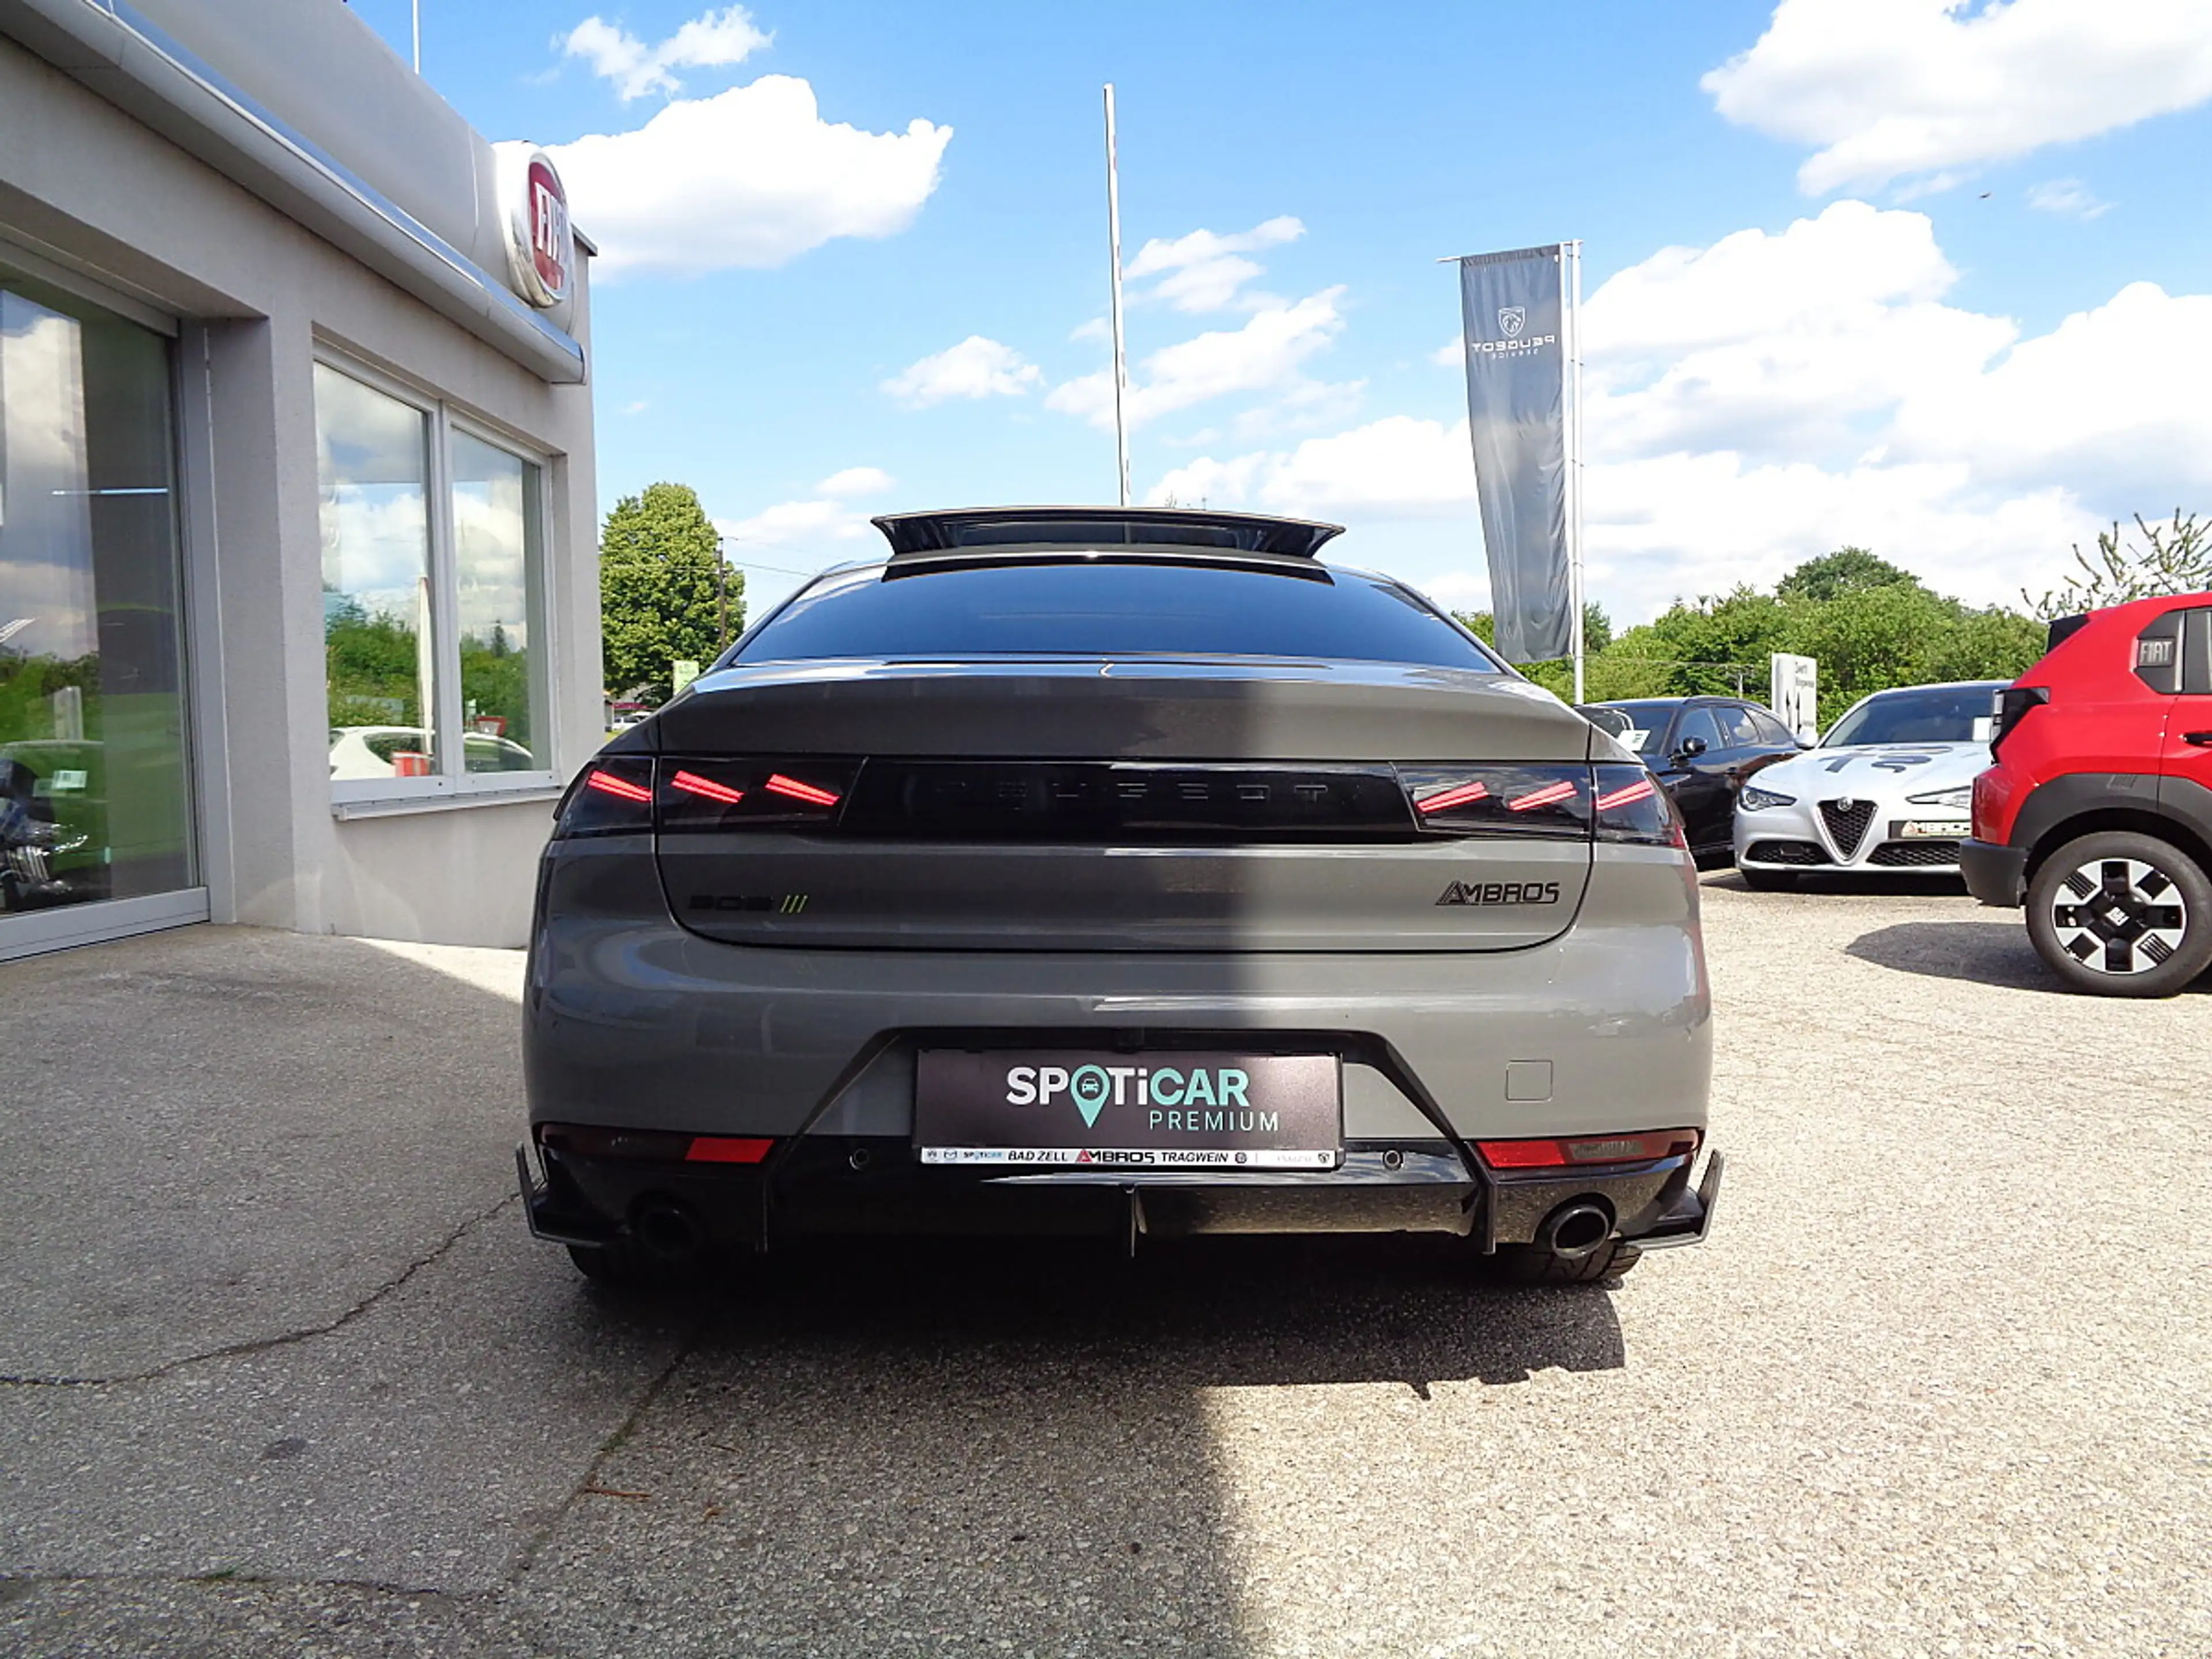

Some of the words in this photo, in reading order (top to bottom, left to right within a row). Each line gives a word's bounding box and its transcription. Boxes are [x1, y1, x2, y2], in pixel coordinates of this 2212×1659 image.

[2140, 641, 2172, 663] FIAT
[1435, 880, 1560, 906] AMBROS
[1150, 1109, 1278, 1131] PREMIUM
[1008, 1150, 1035, 1161] BAD
[1037, 1150, 1067, 1161] ZELL
[1075, 1149, 1155, 1164] AMBROS
[1161, 1152, 1229, 1162] TRAGWEIN
